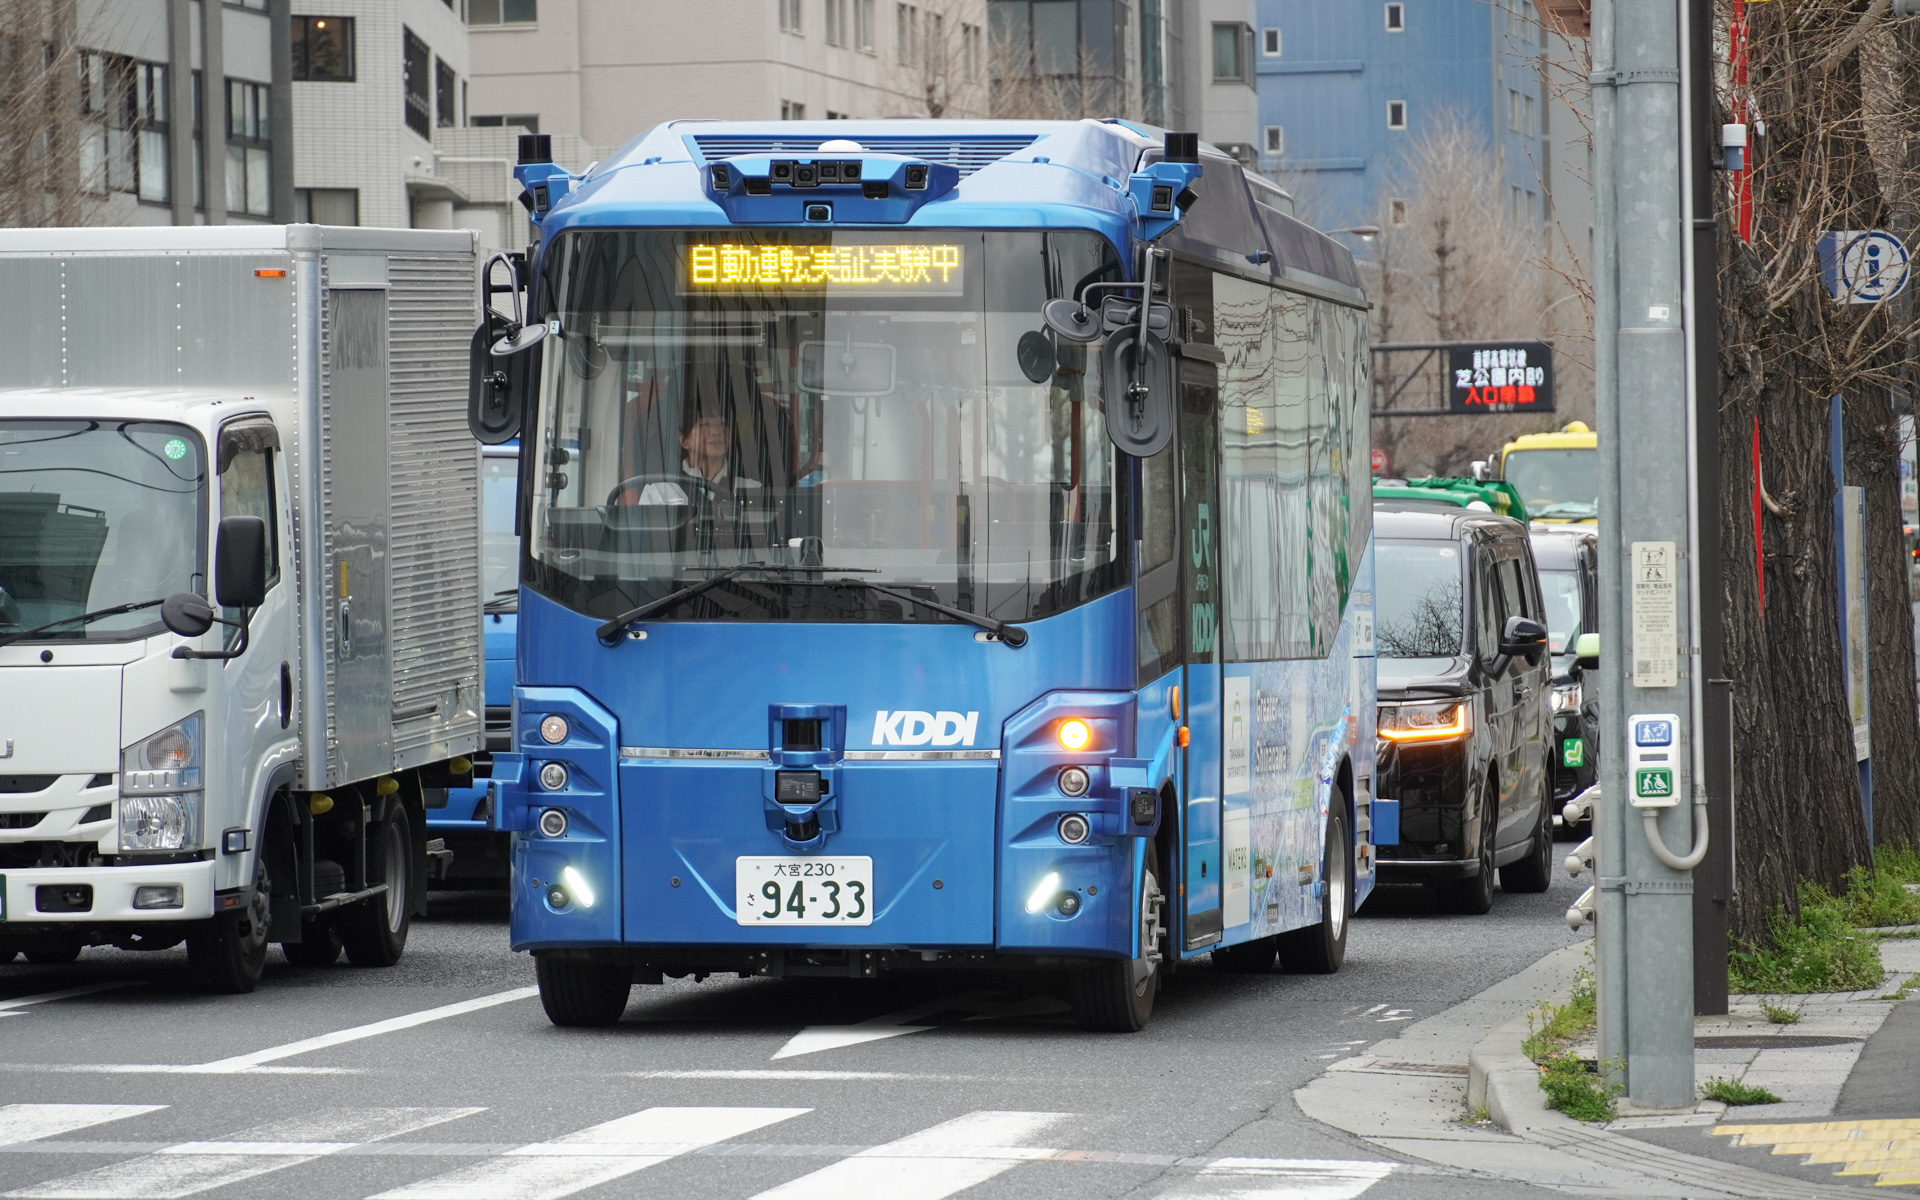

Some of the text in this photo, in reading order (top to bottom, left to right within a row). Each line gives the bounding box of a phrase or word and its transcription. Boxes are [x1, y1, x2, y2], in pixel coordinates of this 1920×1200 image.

[691, 243, 959, 284] 自動運転実証実験中
[1192, 503, 1210, 568] JR
[1192, 603, 1214, 653] KDDI
[1256, 689, 1279, 723] Greater
[871, 710, 979, 746] KDDI
[1256, 739, 1287, 779] Shinagawa
[1227, 846, 1247, 872] WATERS
[747, 880, 865, 919] さ 94-33
